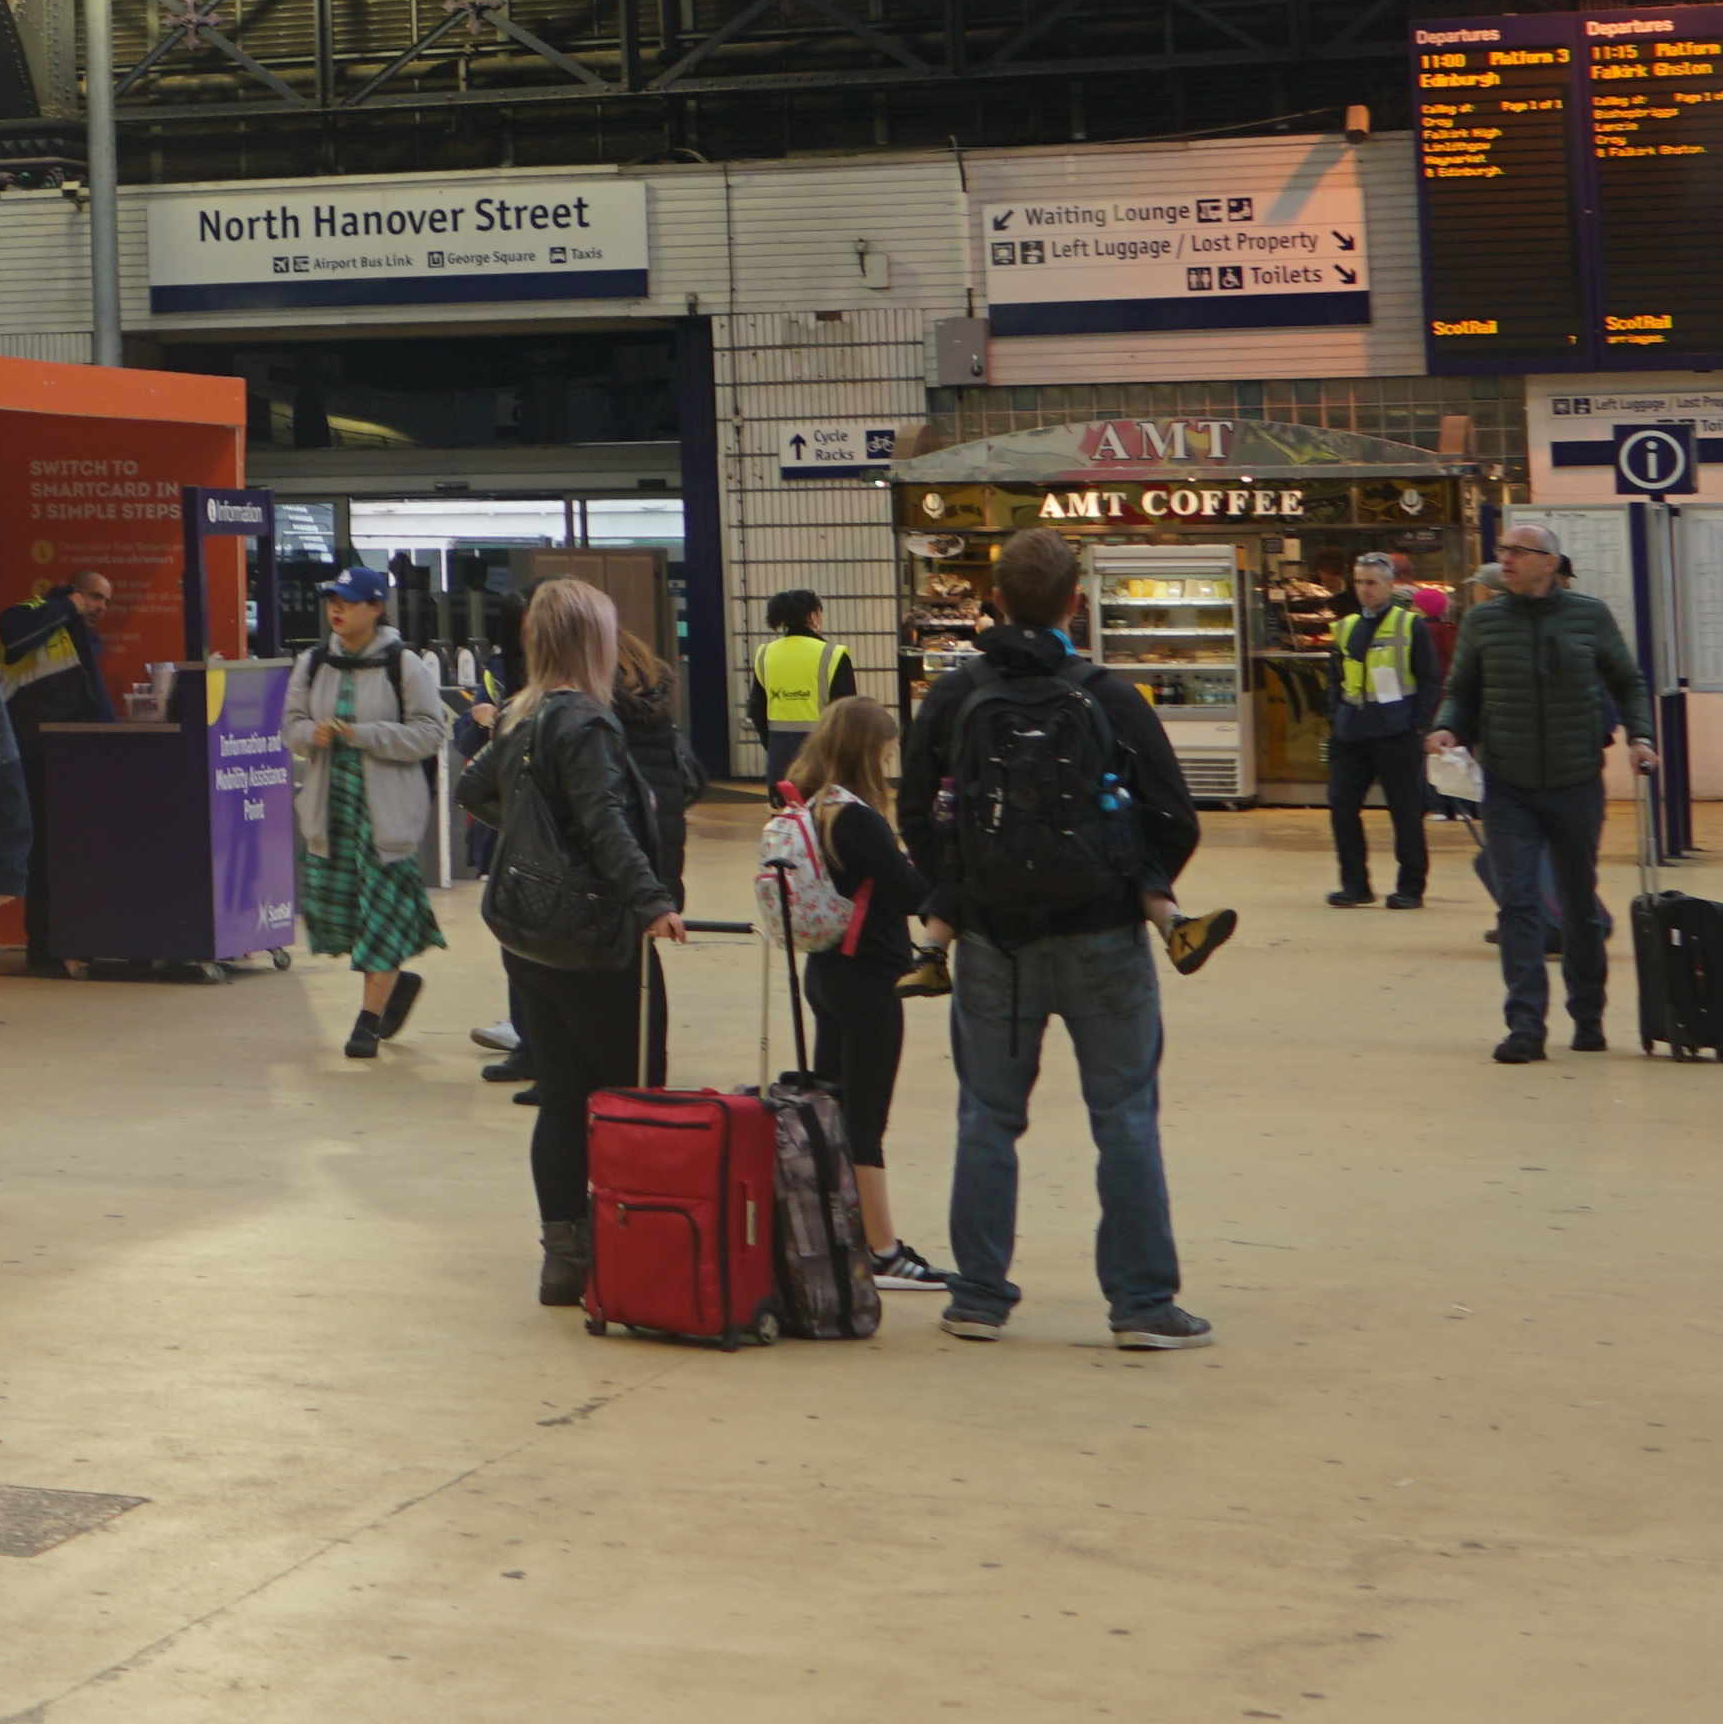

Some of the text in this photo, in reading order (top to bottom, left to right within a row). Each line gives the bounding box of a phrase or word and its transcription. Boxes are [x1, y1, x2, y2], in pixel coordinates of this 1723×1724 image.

[1415, 29, 1500, 47] Departures
[1586, 20, 1674, 39] Departures
[1420, 49, 1571, 69] 11:00 Platform 3
[1592, 43, 1721, 60] 11:15 Platform
[1419, 72, 1500, 88] Edinburgh
[1590, 65, 1649, 79] Falkirk
[198, 196, 591, 242] North Hanover Street
[1025, 202, 1190, 227] Waiting Lounge
[570, 248, 603, 260] Taxis
[1052, 230, 1319, 260] Left Luggage Lost Property
[313, 253, 413, 272] Airport Bus Link
[447, 249, 535, 267] George Square
[1250, 265, 1322, 285] Toilets
[1432, 320, 1498, 336] ScotRail
[1605, 314, 1673, 331] ScotRail
[1594, 397, 1700, 412] Left Luggage Lost
[814, 429, 849, 444] Cycle
[1091, 421, 1234, 461] AMT
[815, 448, 854, 461] Racks
[30, 460, 139, 476] SWITCH TO
[31, 481, 180, 497] SMARTCARD IN
[31, 503, 181, 519] 3 SIMPLE STEPS
[216, 500, 263, 523] Information
[1038, 490, 1304, 519] AMT COFFEE
[220, 730, 281, 757] Information and
[215, 763, 288, 794] Mobility Assistance
[243, 797, 265, 821] Point
